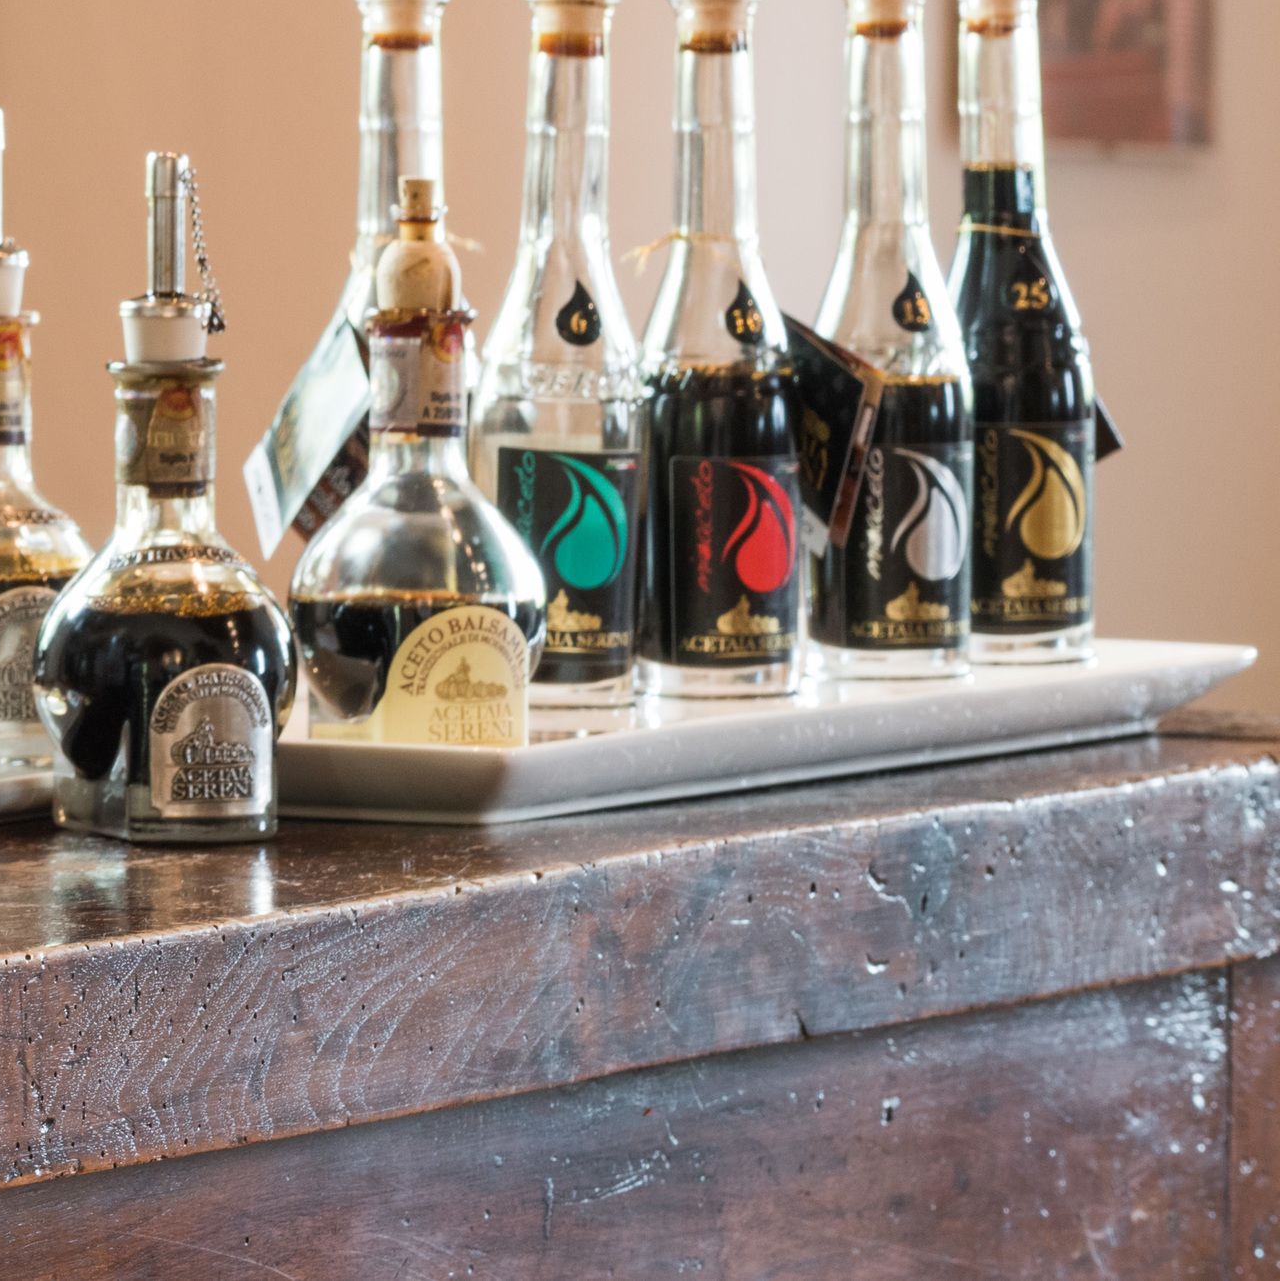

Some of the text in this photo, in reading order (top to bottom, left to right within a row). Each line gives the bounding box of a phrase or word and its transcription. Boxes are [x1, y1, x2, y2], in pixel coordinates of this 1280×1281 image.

[1012, 282, 1050, 310] 25
[400, 627, 444, 696] ACETO
[432, 703, 512, 721] ACETAIA
[429, 720, 513, 742] SERENI
[171, 782, 252, 799] SEREN
